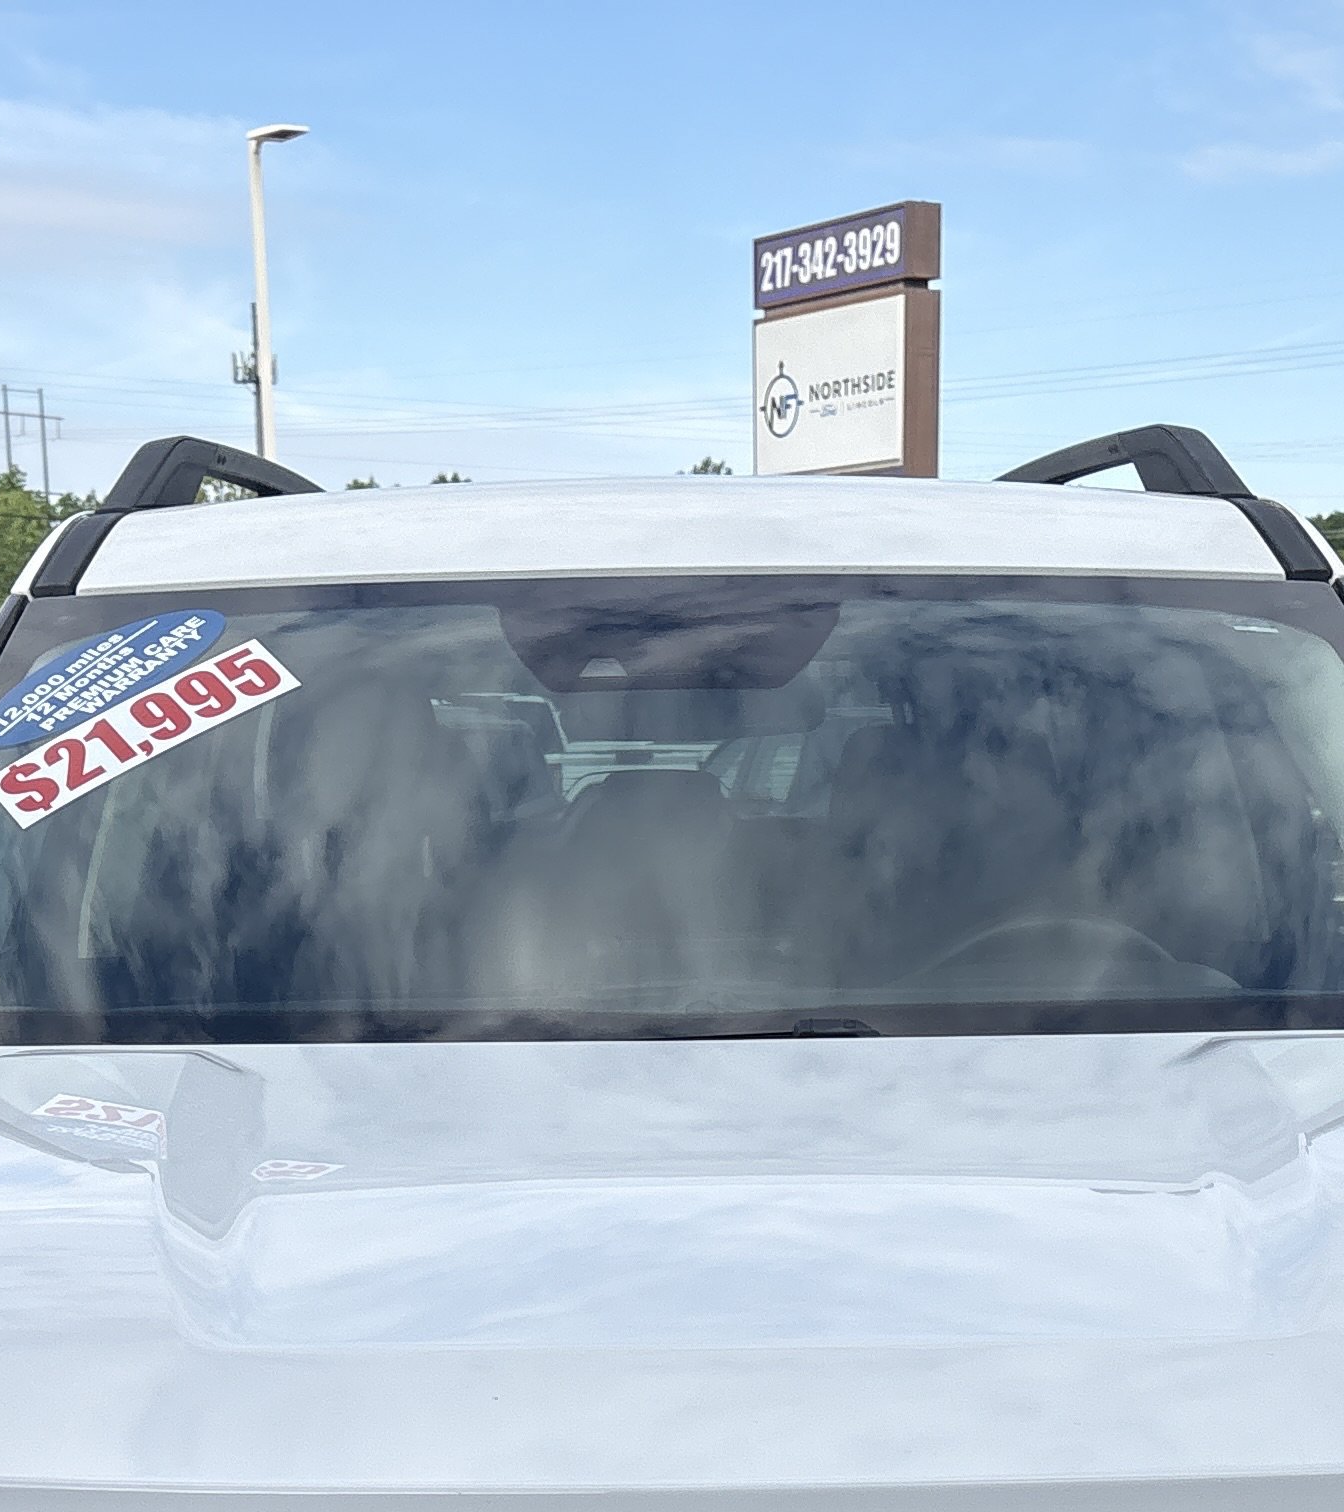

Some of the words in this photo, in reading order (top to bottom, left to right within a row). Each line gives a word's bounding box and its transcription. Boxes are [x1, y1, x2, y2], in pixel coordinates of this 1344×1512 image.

[760, 221, 901, 292] 217-342-3929
[808, 370, 895, 402] NORTHSIDE
[25, 701, 58, 723] 12
[53, 646, 135, 702] Months
[38, 656, 145, 731] PREMIUM
[143, 615, 207, 657] CARE
[64, 633, 124, 674] miles
[78, 627, 202, 714] WARRANTY
[0, 648, 282, 812] $21,995
